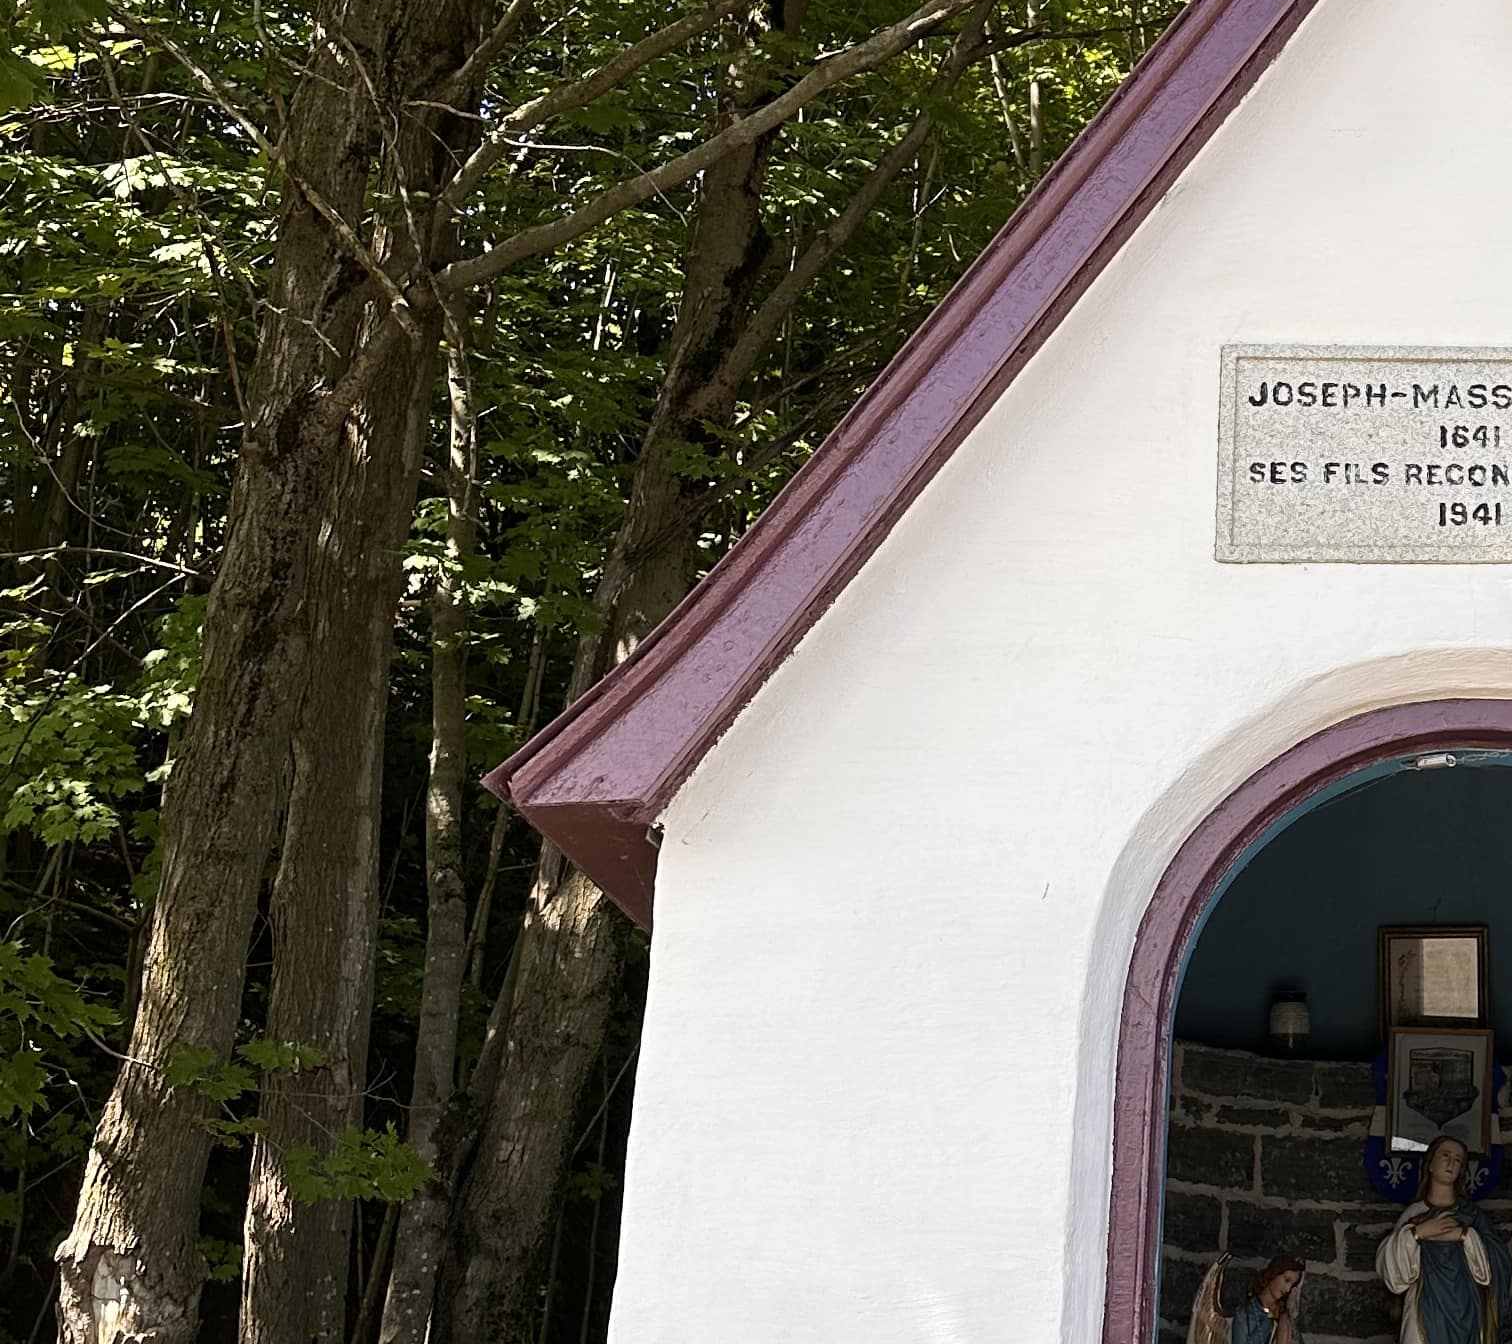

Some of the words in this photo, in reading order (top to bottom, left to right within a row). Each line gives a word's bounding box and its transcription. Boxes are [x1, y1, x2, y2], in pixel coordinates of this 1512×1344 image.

[1439, 424, 1500, 448] 1641
[1249, 462, 1309, 484] SES
[1323, 462, 1390, 485] FILS
[1438, 502, 1500, 527] 1941
